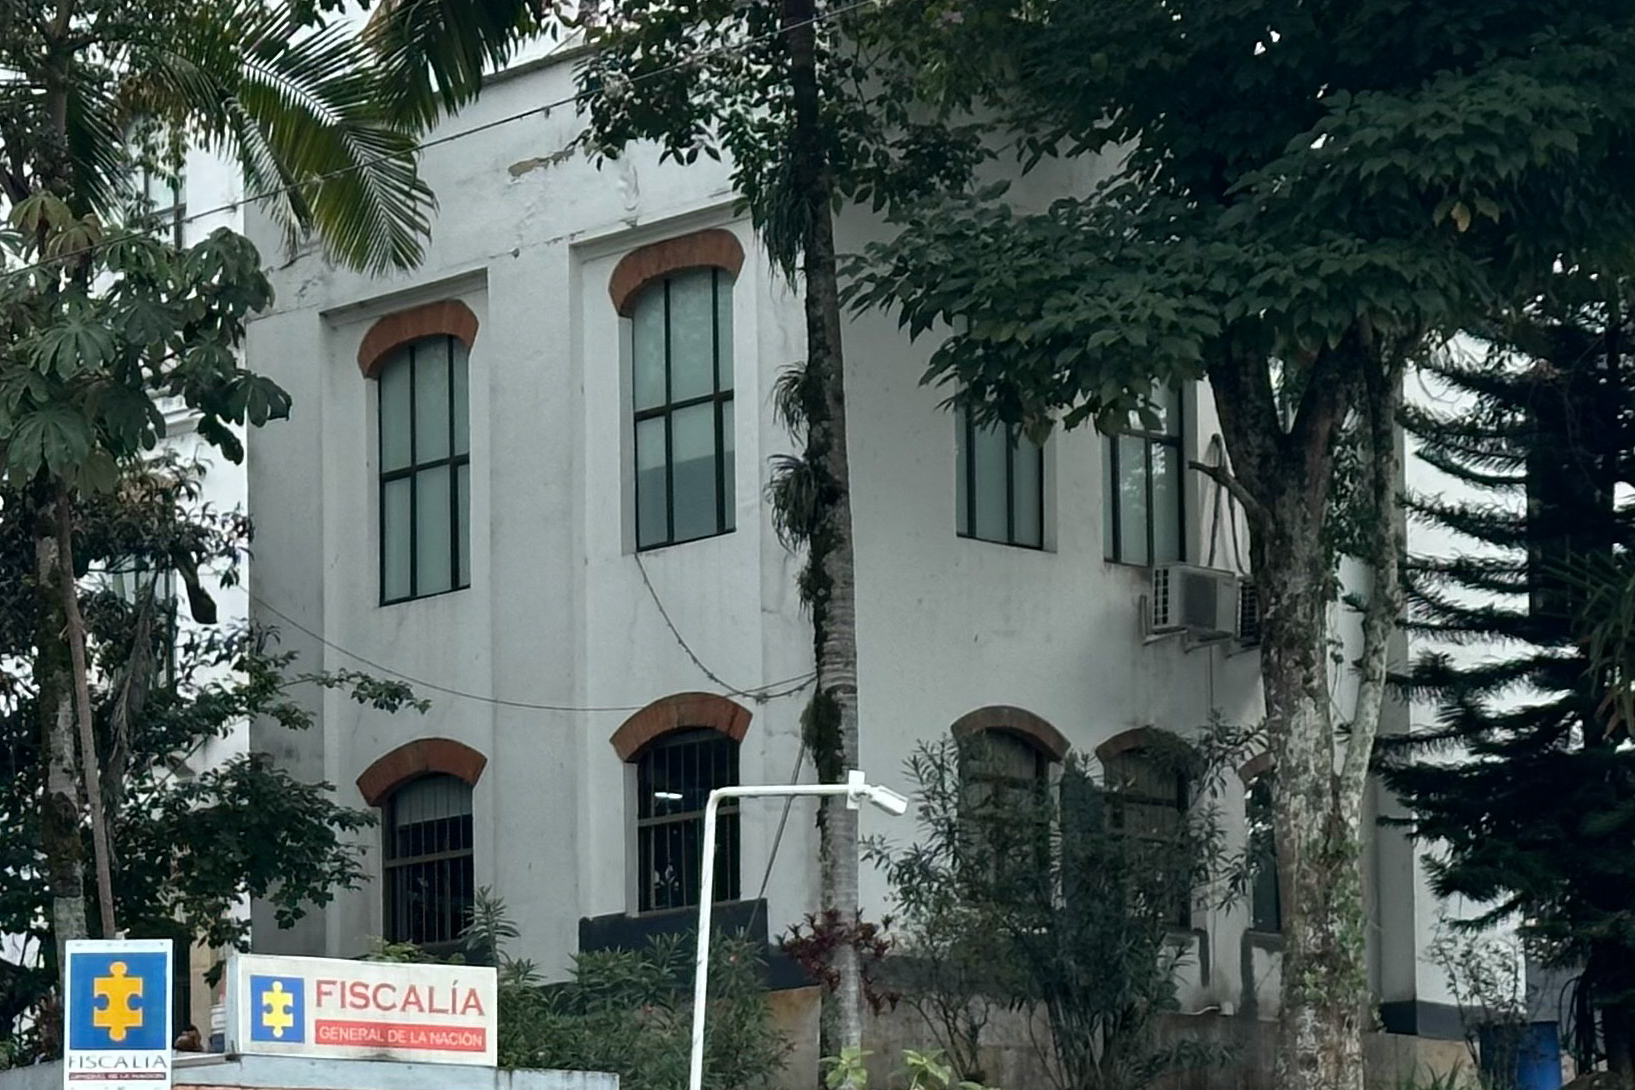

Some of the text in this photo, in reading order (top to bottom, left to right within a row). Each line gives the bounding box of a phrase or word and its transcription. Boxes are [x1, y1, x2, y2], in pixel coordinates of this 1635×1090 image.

[315, 979, 485, 1017] FISCALÍA
[319, 1026, 384, 1043] GENERAL
[388, 1029, 405, 1043] DE
[410, 1031, 427, 1044] LA
